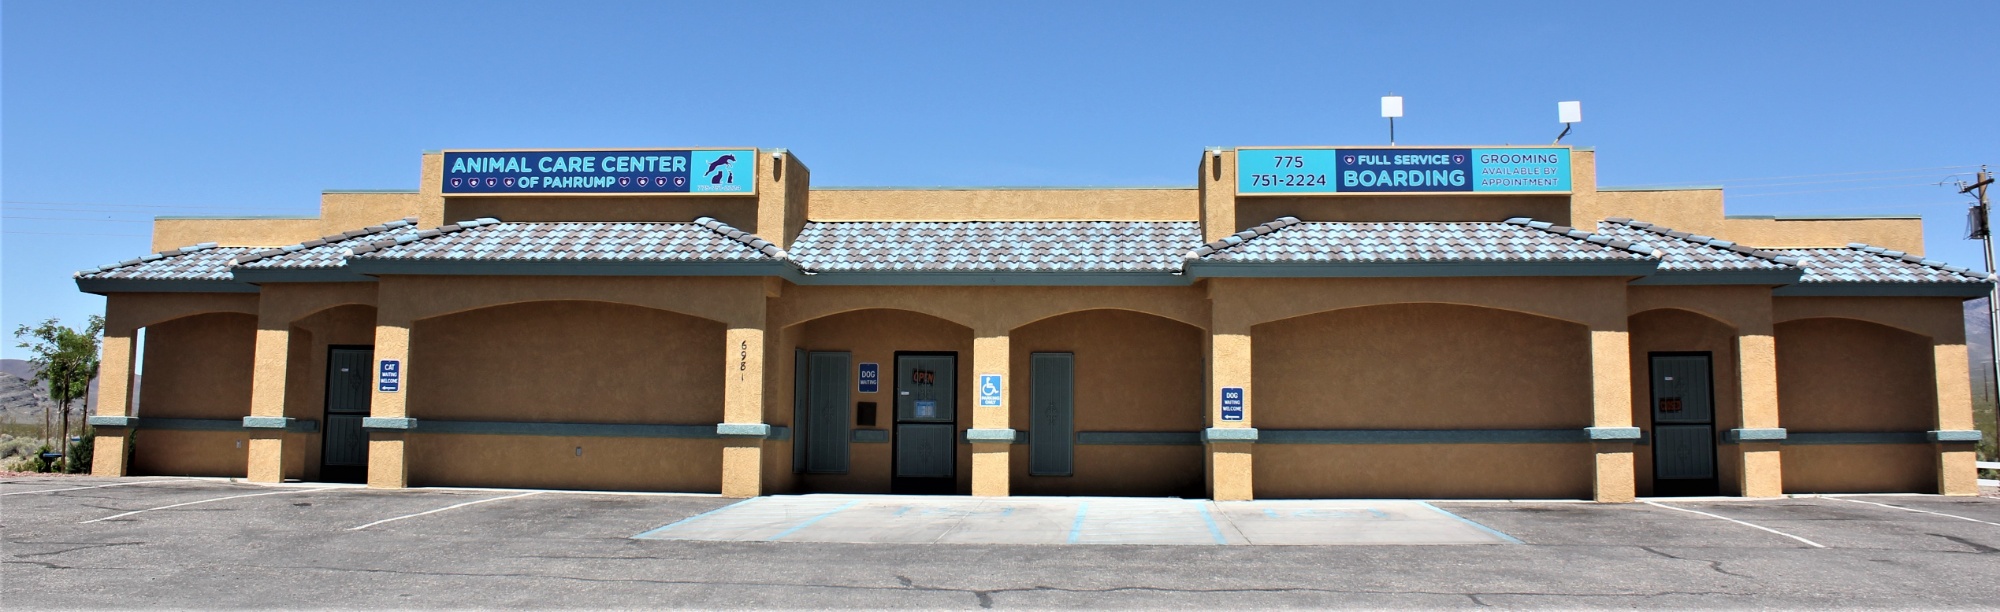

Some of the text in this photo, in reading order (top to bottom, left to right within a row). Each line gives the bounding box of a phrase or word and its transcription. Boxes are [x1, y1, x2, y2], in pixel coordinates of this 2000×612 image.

[451, 155, 687, 173] ANIMAL CARE CENTER
[1274, 156, 1304, 168] 775
[1358, 154, 1450, 165] FULL SERVICE
[1480, 154, 1558, 164] GROOMING
[1482, 167, 1557, 175] AVAILABLE BY
[518, 176, 616, 188] OF PAHRUMP
[1251, 174, 1326, 187] 751-2224
[1343, 169, 1466, 187] BOARDING
[1481, 178, 1559, 186] APPOINTMENT
[384, 363, 396, 371] CAT
[861, 370, 876, 378] DOG
